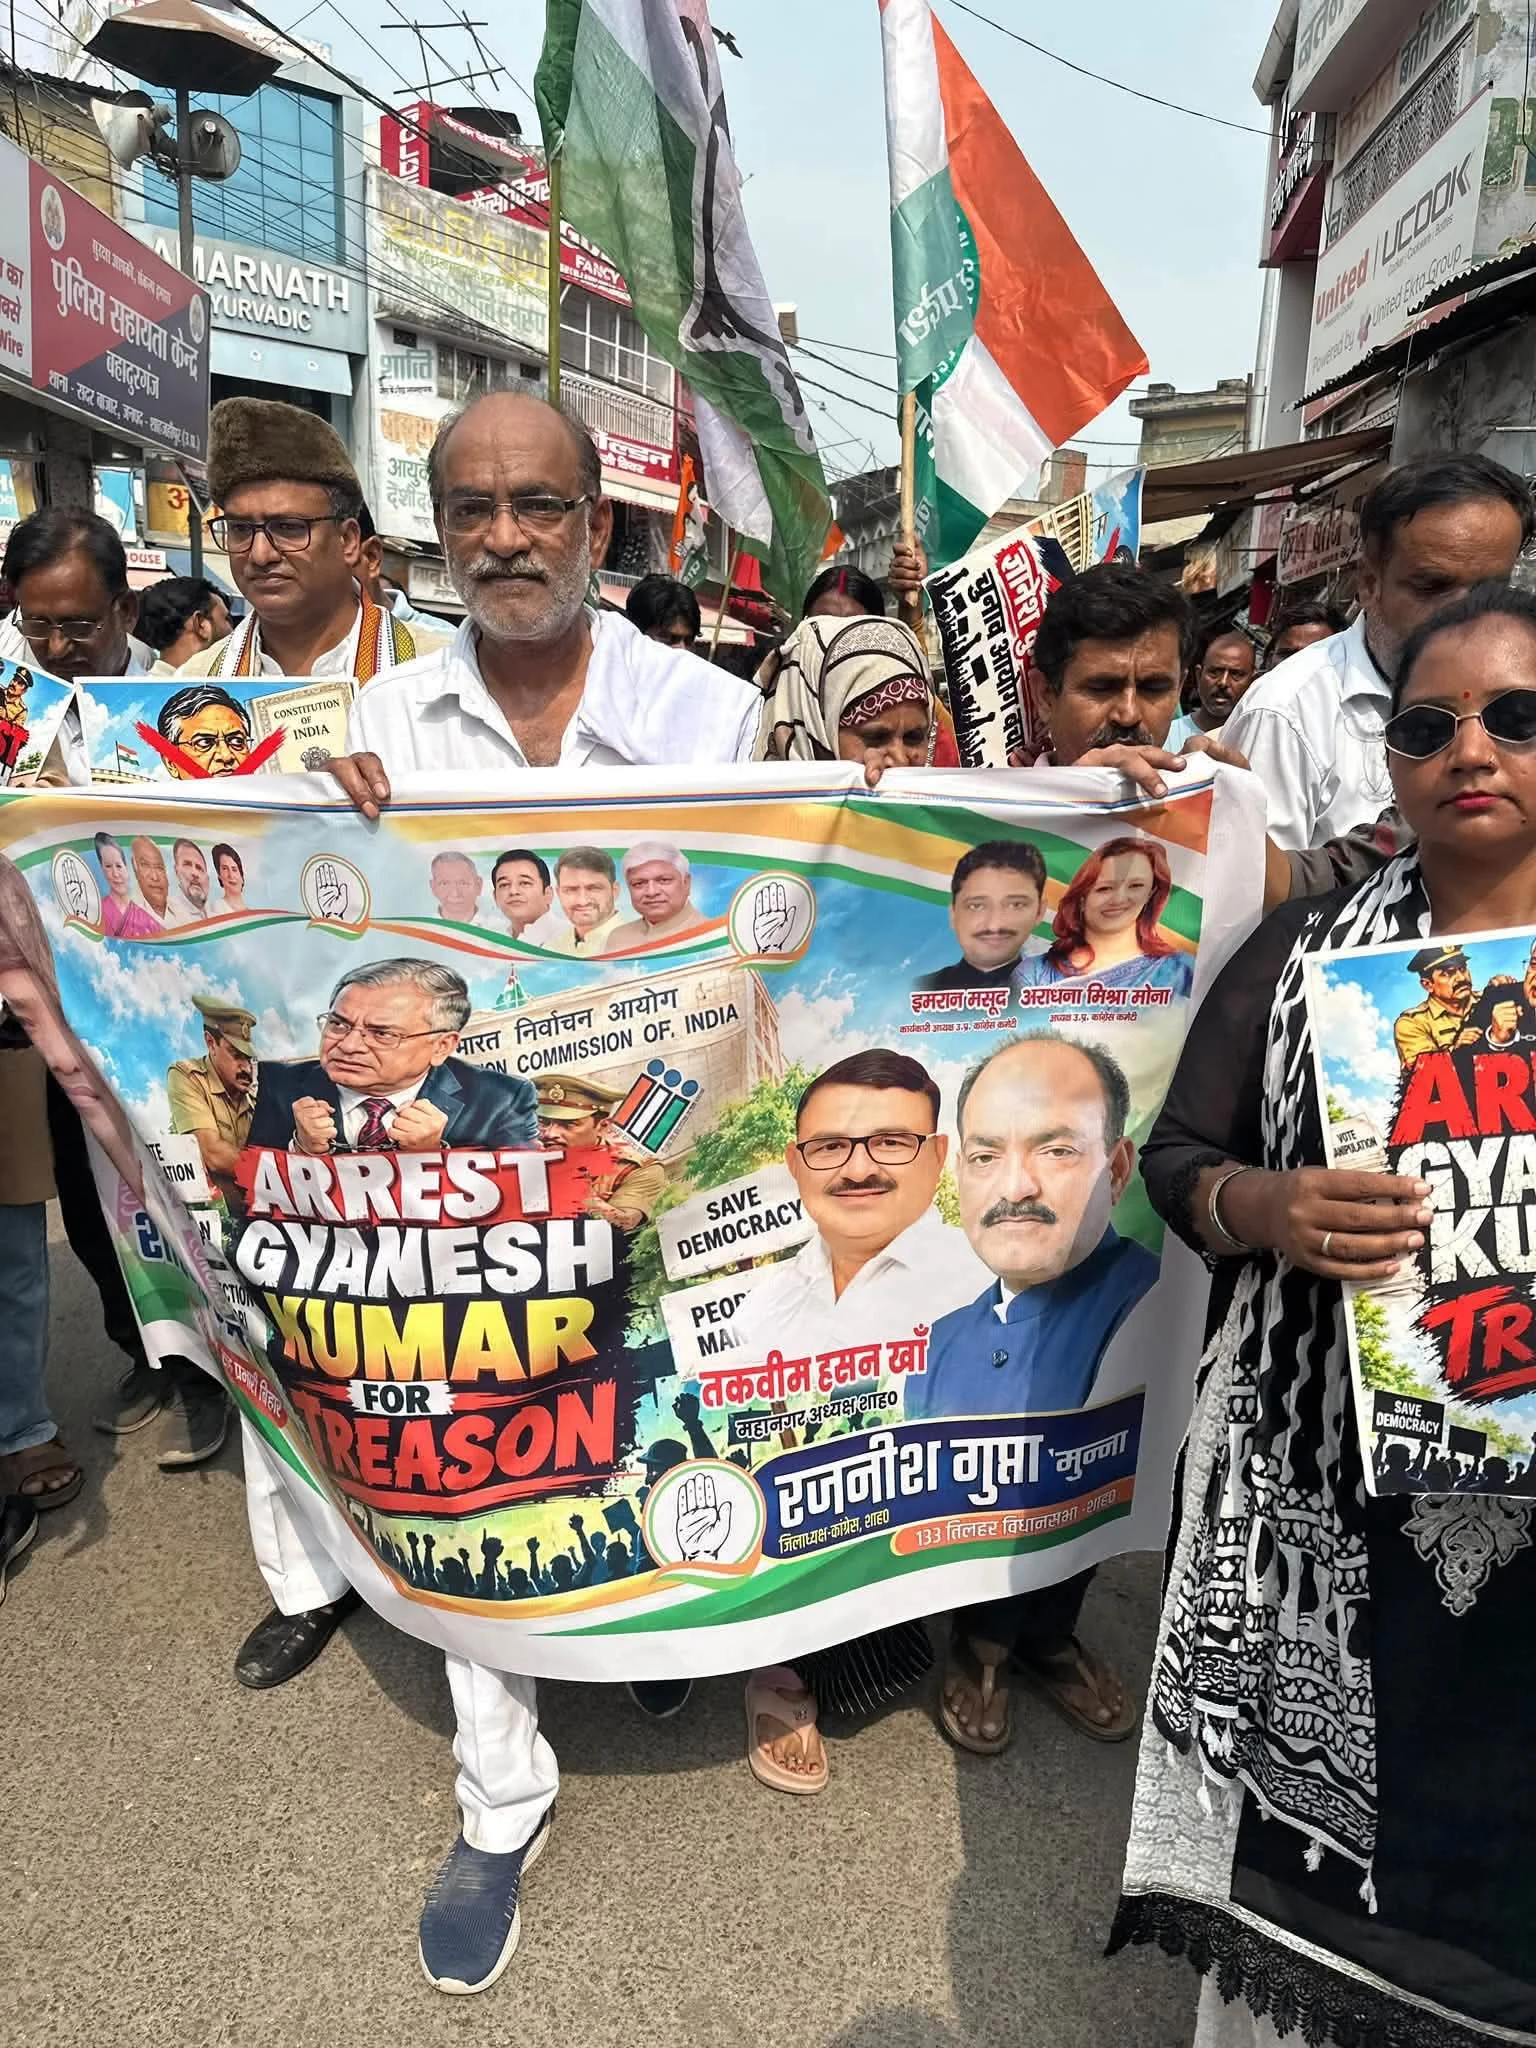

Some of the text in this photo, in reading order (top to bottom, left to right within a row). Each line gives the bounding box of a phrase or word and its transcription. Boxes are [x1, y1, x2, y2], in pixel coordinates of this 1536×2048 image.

[575, 254, 621, 286] FANCY
[51, 257, 106, 326] पुलिस
[109, 296, 168, 361] सहायता
[210, 292, 312, 332] YURVADIC
[49, 369, 69, 394] थाना
[127, 552, 162, 565] OUSE
[967, 567, 1006, 640] चुनाव
[989, 636, 1020, 713] आयोग
[274, 699, 340, 719] CONSTITUTION
[301, 716, 311, 724] OF
[293, 724, 330, 740] INDIA
[911, 987, 1010, 1014] इमरान मसूद
[1087, 982, 1129, 1006] मिश्रा
[1131, 982, 1171, 1006] मोना
[514, 1008, 593, 1044] निर्वाचन
[608, 986, 679, 1023] आयोग
[517, 1028, 634, 1076] COMMISSION
[685, 1003, 739, 1033] INDIA
[1336, 1129, 1357, 1143] VOTE
[253, 1151, 565, 1223] ARREST
[706, 1186, 762, 1222] SAVE
[677, 1199, 804, 1260] DEMOCRACY
[235, 1219, 614, 1297] GYANESH
[264, 1294, 599, 1382] KUMAR
[700, 1324, 930, 1408] तकवीम हसन खाँ
[362, 1384, 431, 1414] FOR
[736, 1412, 806, 1438] महानगर
[810, 1399, 856, 1422] अध्यक्ष
[1394, 1400, 1422, 1418] SAVE
[295, 1378, 616, 1492] TREASON
[1376, 1411, 1440, 1436] DEMOCRACY
[774, 1432, 942, 1529] रजनीश
[950, 1434, 1044, 1507] गुप्ता
[916, 1527, 942, 1547] 133
[945, 1518, 998, 1542] तिलहर
[1002, 1505, 1078, 1536] विधानसभा
